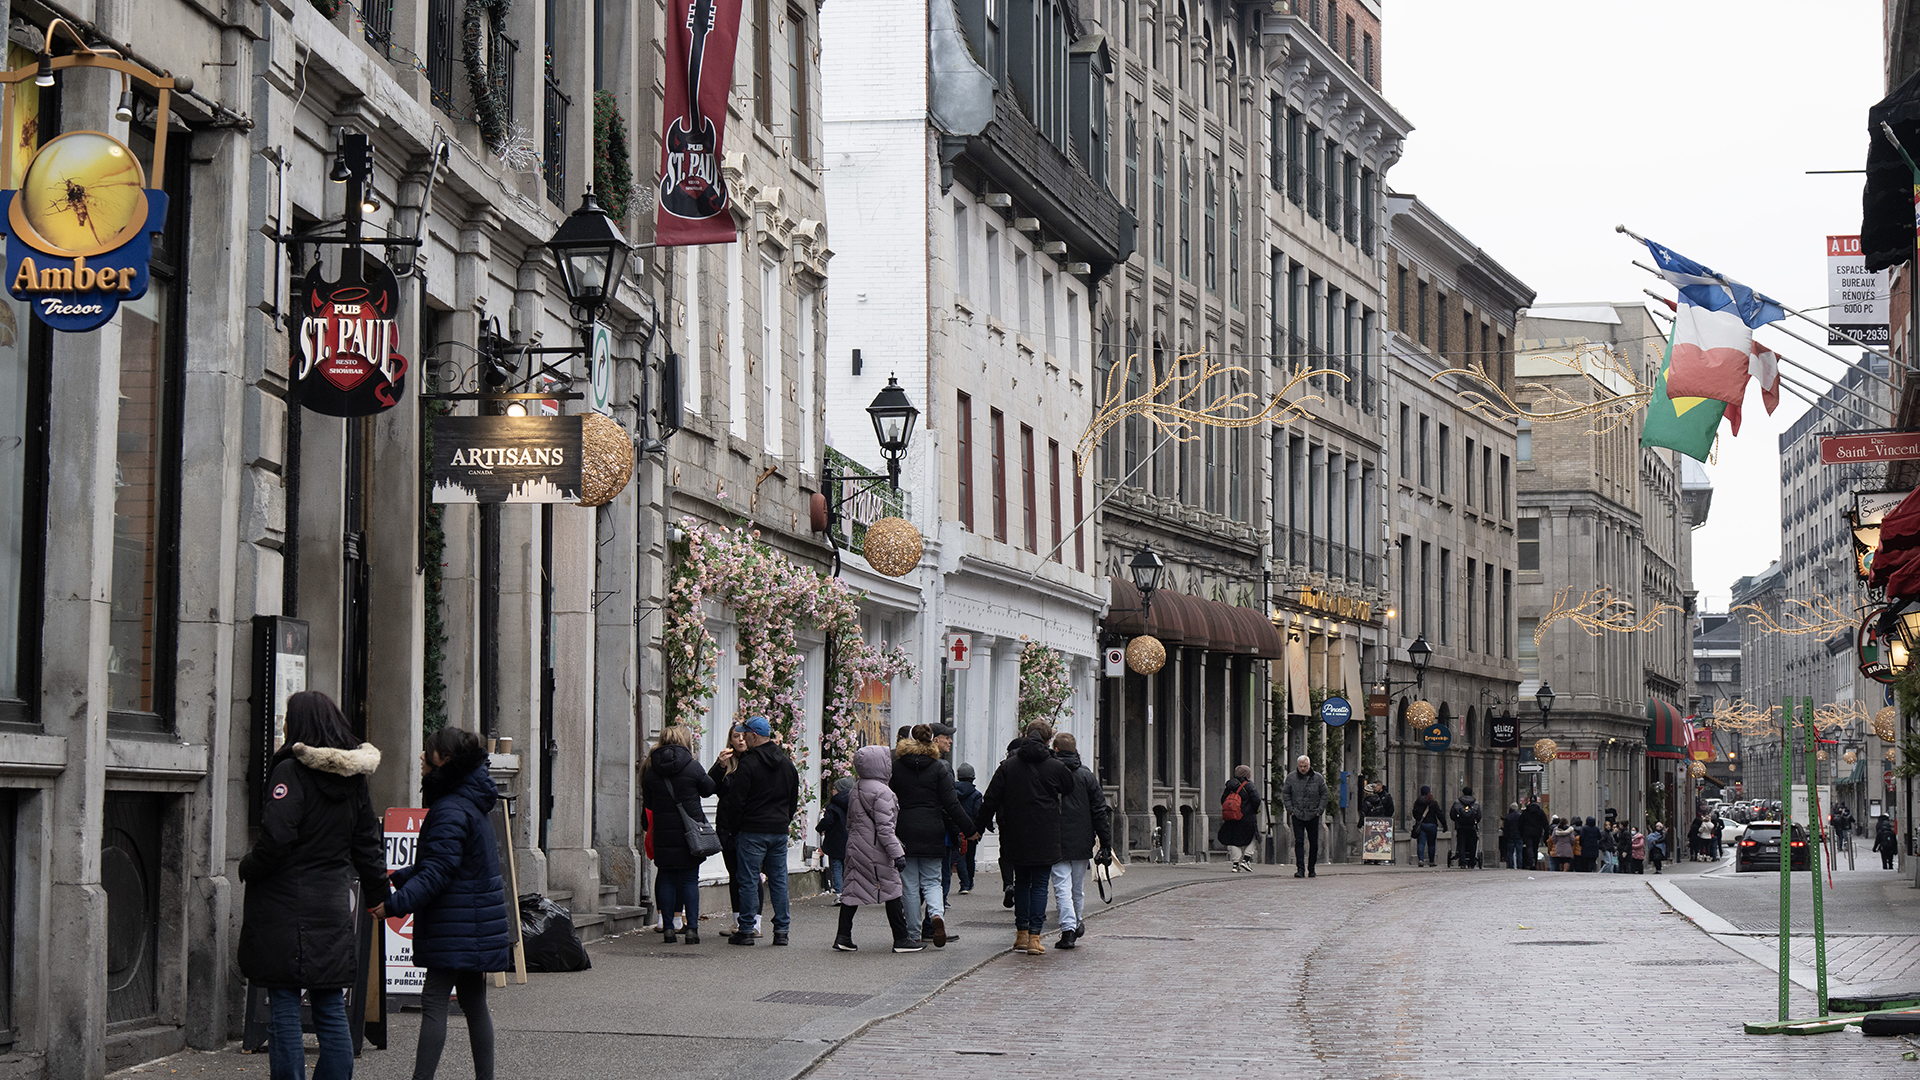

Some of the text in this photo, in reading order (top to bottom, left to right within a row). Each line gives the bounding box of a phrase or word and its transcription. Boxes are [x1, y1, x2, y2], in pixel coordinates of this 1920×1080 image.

[687, 143, 703, 151] PUB
[667, 152, 720, 197] ST. PAUL
[1831, 236, 1840, 252] À
[12, 256, 137, 293] Amber
[1841, 279, 1876, 287] BUREAUX
[1842, 289, 1876, 300] RÉNOVÉS
[41, 298, 102, 315] Tresor
[333, 304, 361, 315] PUB
[1844, 304, 1874, 314] 6000 PC
[299, 316, 395, 387] ST. PAUL
[450, 448, 564, 470] ARTISANS
[1836, 443, 1920, 459] Saint-Vincent
[1494, 723, 1514, 733] DÉLICES
